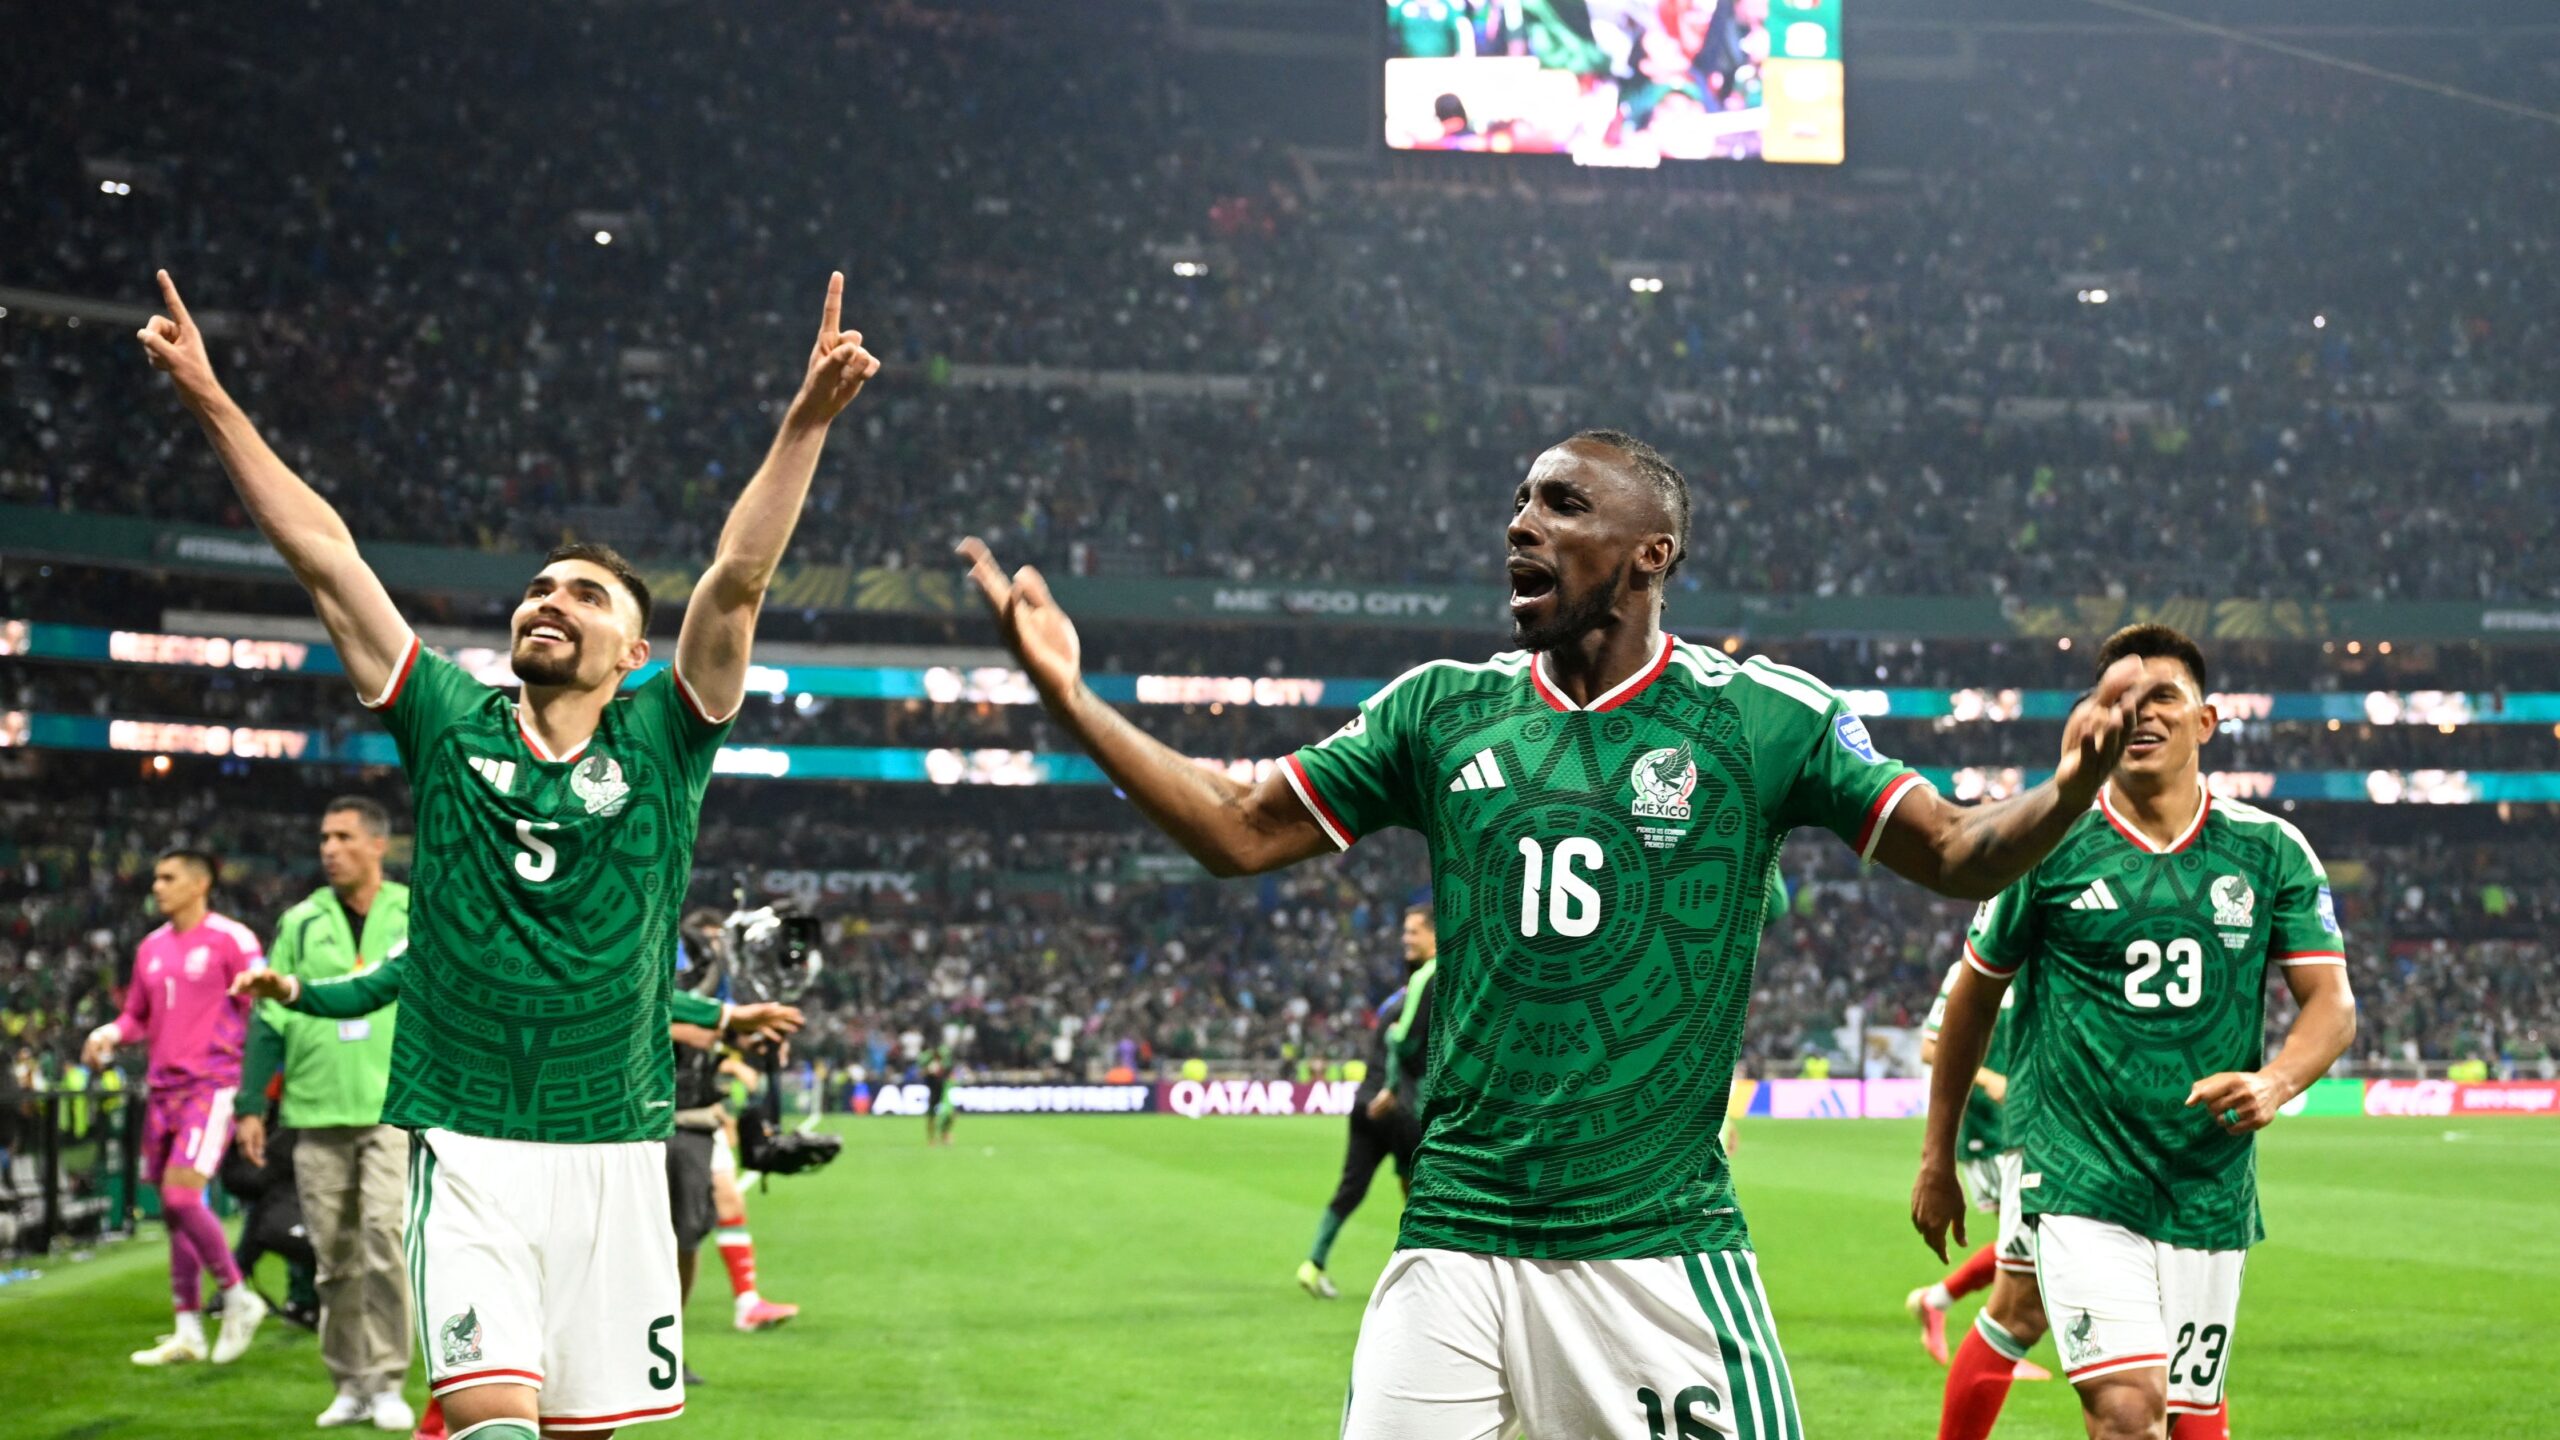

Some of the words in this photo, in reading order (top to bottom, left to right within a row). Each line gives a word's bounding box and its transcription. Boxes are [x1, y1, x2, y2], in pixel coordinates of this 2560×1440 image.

[1213, 589, 1359, 614] MEICO
[1364, 591, 1449, 616] CITY
[1634, 801, 1689, 818] MÉXICO
[515, 818, 560, 882] 5
[1518, 836, 1604, 938] 16
[2124, 937, 2202, 1008] 23
[1169, 1080, 1295, 1119] QATAR
[648, 1314, 677, 1391] 5
[2168, 1321, 2227, 1387] 23
